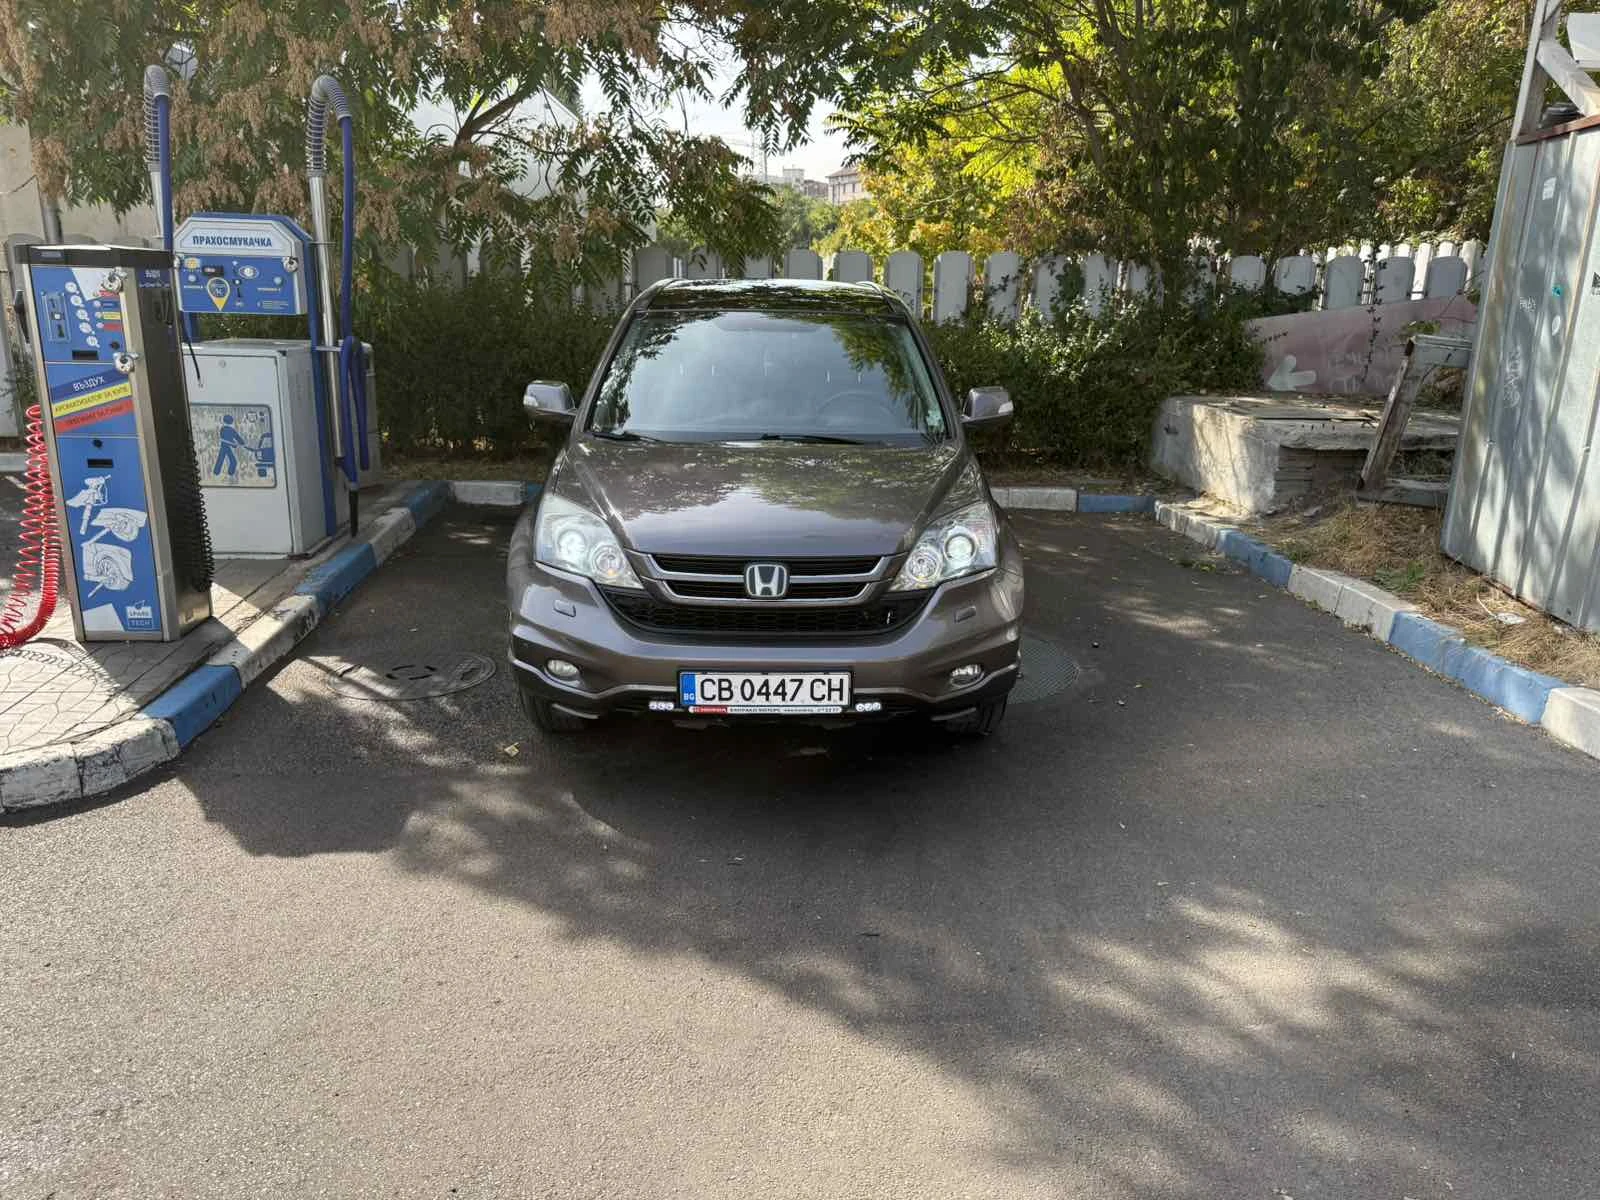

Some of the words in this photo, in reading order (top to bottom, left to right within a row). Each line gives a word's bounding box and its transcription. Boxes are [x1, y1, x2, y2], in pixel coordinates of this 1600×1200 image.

[192, 235, 273, 248] ПРАХОСМУКАЧКА
[72, 375, 105, 392] ВЪЗДУХ
[683, 693, 695, 701] BG
[700, 678, 734, 702] CB
[740, 678, 804, 702] 0447
[810, 678, 844, 702] CH
